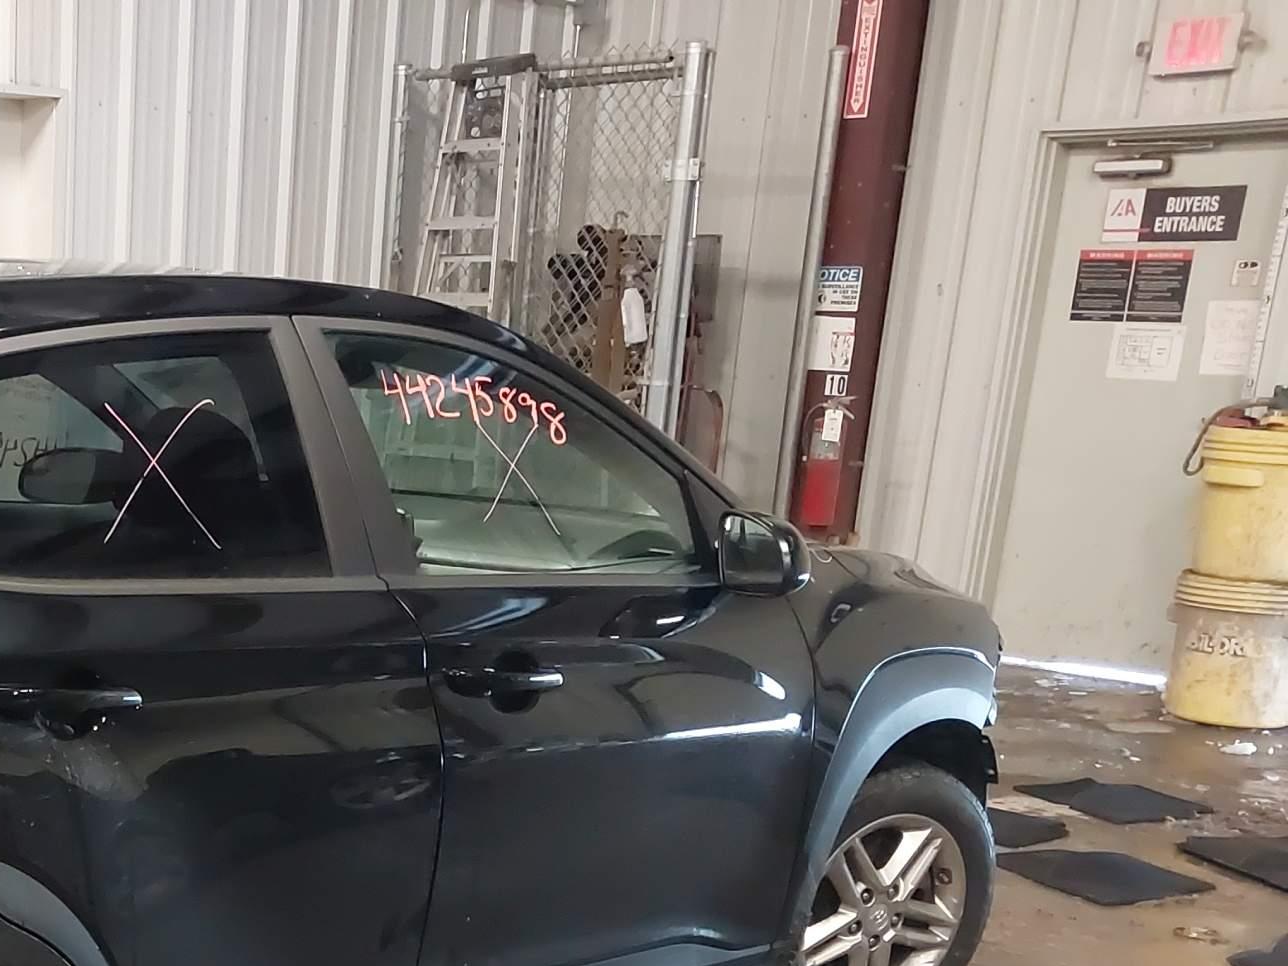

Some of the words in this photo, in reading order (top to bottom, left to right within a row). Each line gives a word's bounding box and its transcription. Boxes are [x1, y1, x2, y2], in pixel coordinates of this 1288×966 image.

[1166, 195, 1221, 213] BUYERS
[1153, 215, 1226, 233] ENTRANCE
[819, 269, 859, 281] OTICE
[829, 375, 847, 396] 10
[380, 368, 567, 446] 44245898
